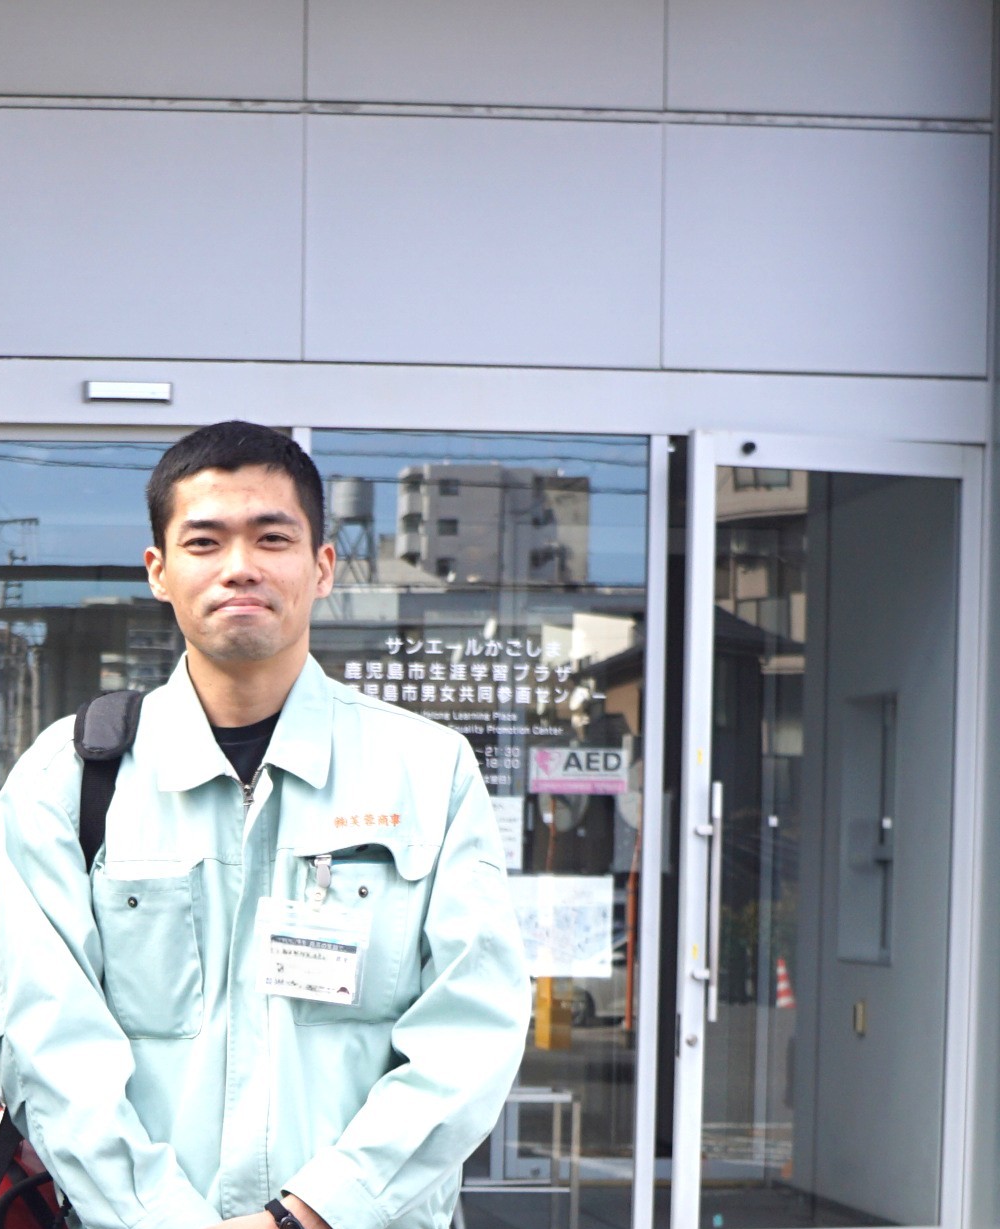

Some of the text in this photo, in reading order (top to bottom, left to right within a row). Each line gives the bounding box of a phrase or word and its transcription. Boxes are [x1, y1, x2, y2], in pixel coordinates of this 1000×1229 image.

[385, 637, 561, 658] サンエールかごしま
[344, 661, 571, 682] 鹿児島市生涯学習プラザ
[492, 711, 518, 721] Plaza
[486, 724, 531, 735] Promotion
[532, 725, 564, 736] Center
[563, 752, 622, 772] AED
